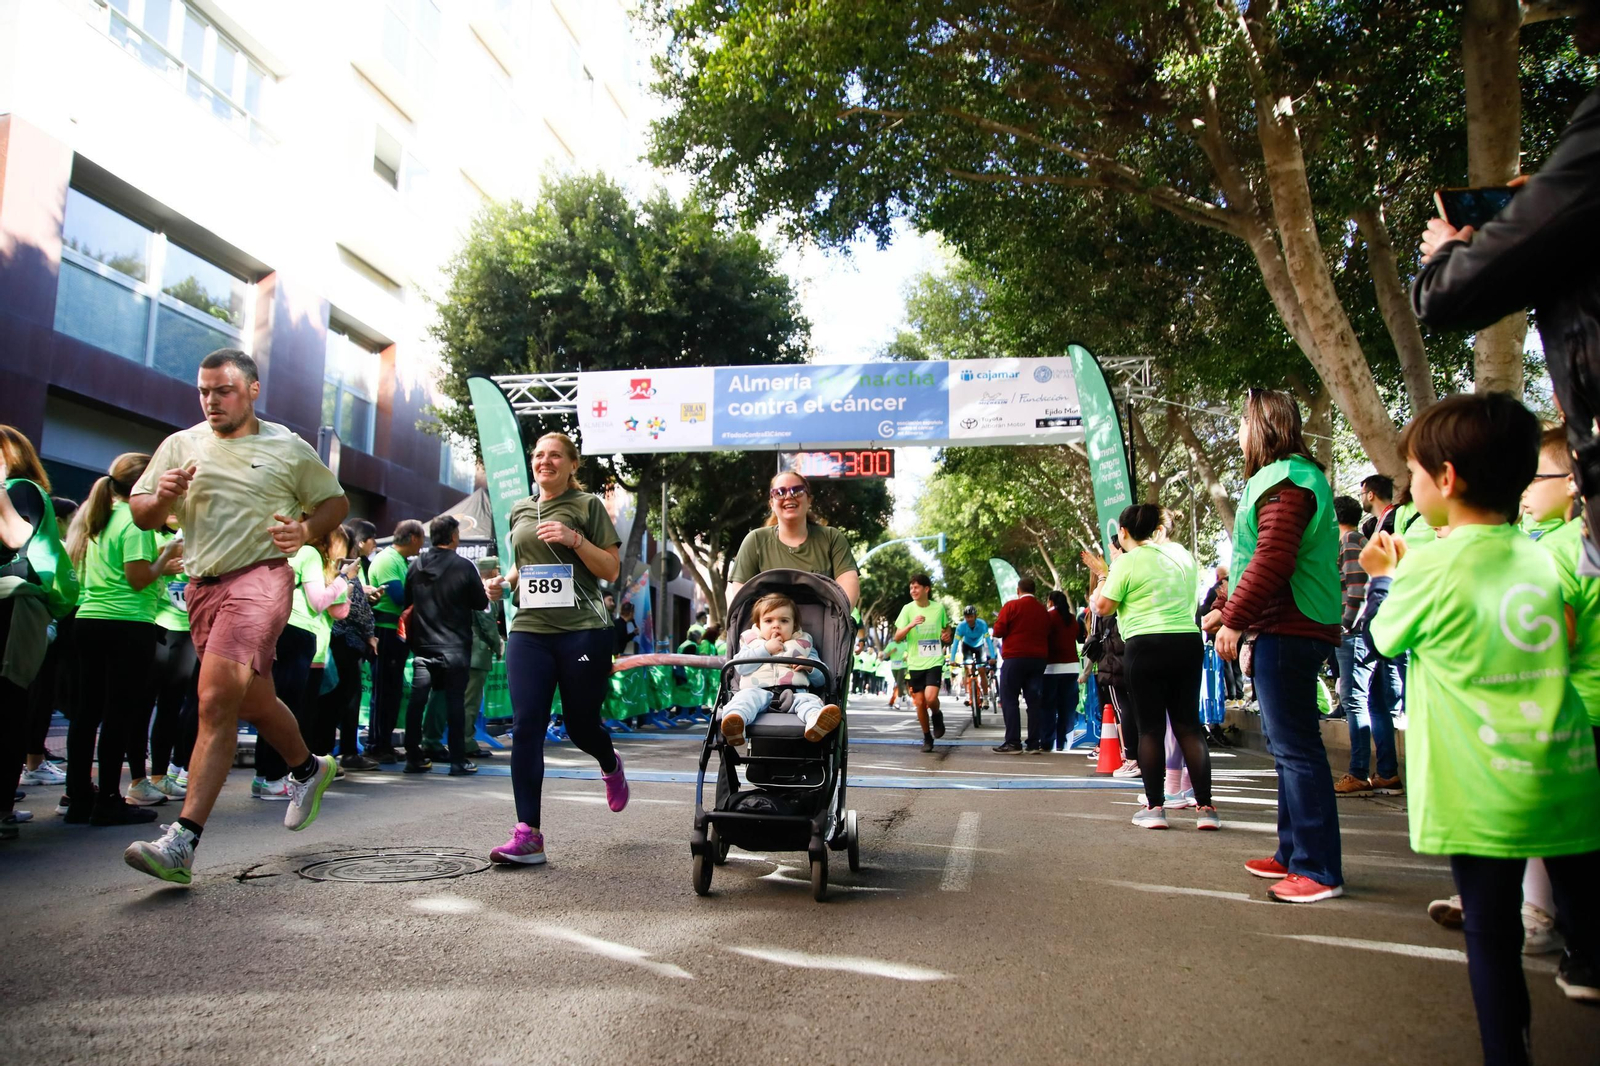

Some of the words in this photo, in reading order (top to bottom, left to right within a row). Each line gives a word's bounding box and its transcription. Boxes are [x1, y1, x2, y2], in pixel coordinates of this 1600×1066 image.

[976, 369, 1020, 381] cajamar
[728, 373, 812, 393] Almería
[1019, 392, 1069, 404] Fundación
[728, 399, 798, 416] contra
[803, 395, 824, 413] el
[830, 395, 907, 412] cáncer
[1045, 408, 1063, 416] Ejido
[528, 578, 563, 594] 589
[922, 644, 937, 652] 711
